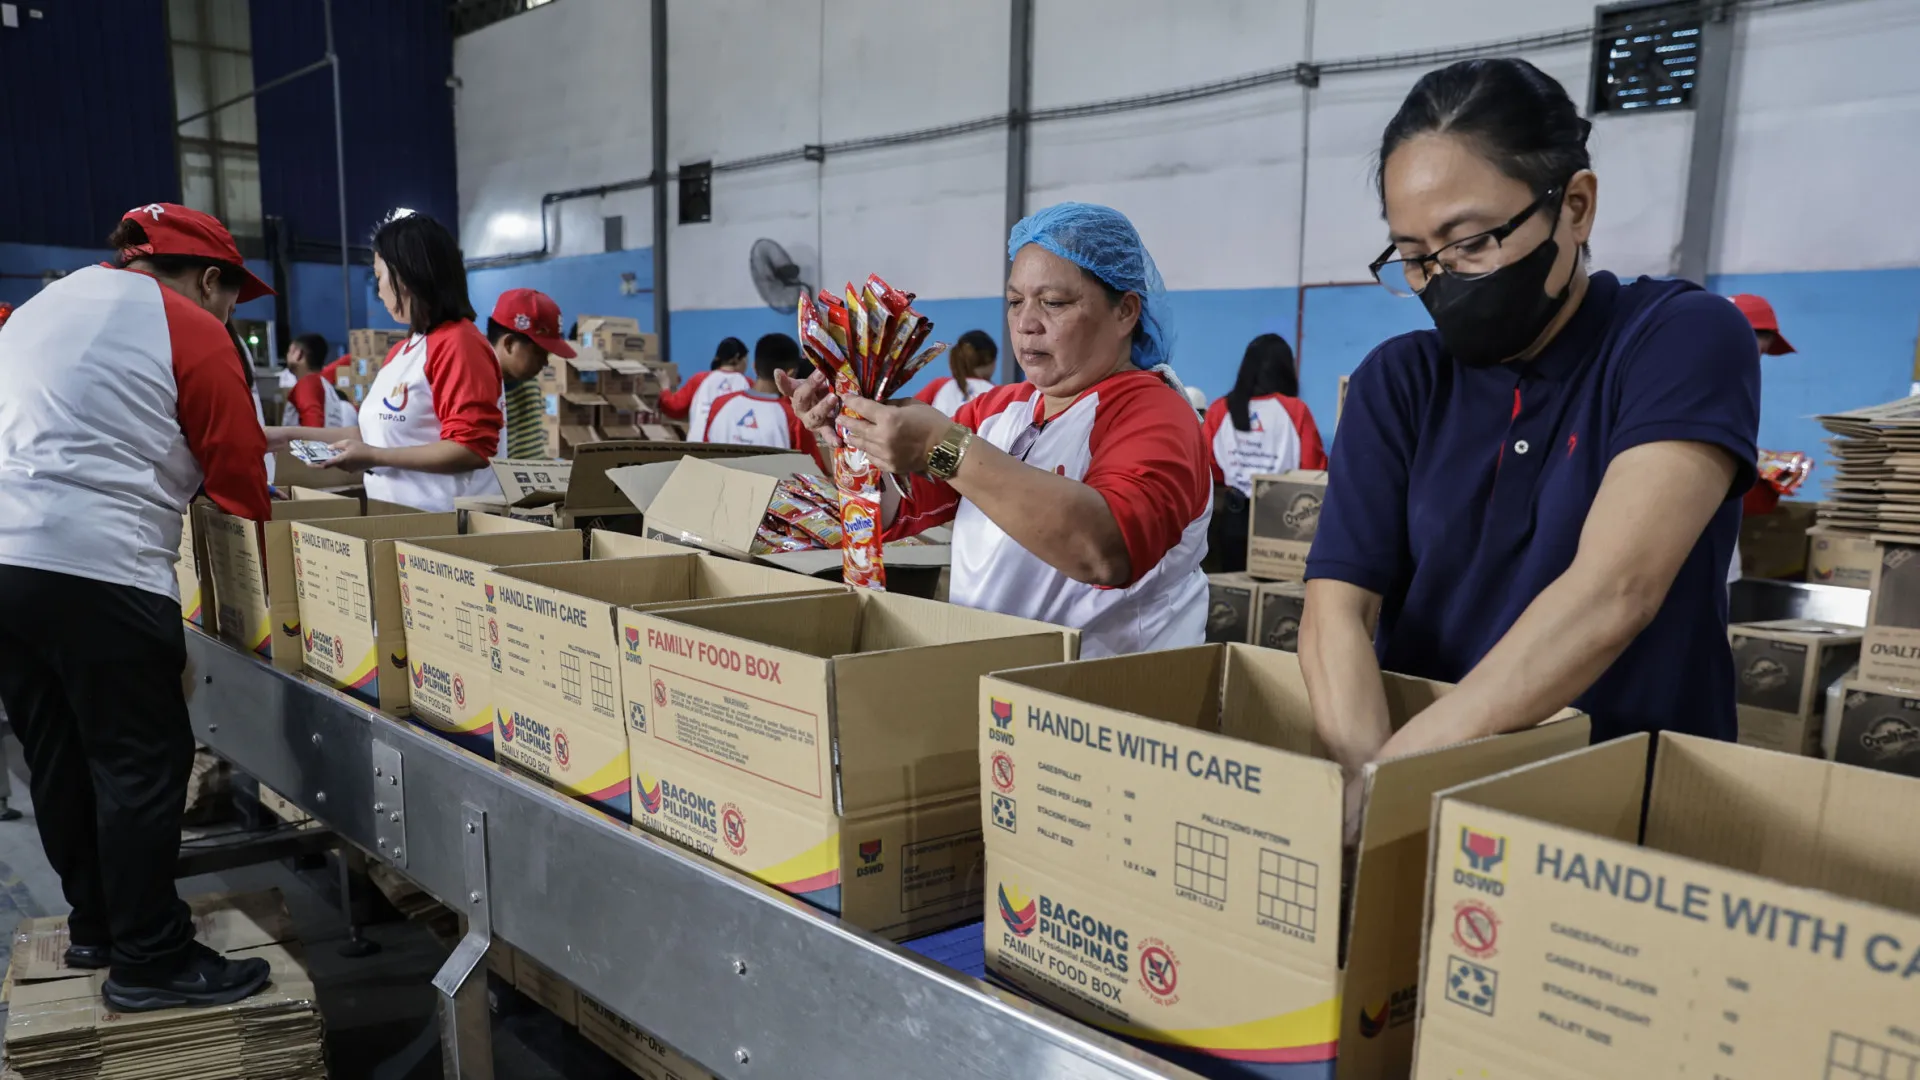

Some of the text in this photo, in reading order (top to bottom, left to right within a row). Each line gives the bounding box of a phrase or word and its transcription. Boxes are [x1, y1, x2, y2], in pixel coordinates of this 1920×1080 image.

[302, 532, 351, 557] HANDLE WITH CARE
[408, 554, 476, 587] HANDLE WITH CARE
[498, 585, 533, 611] HANDLE
[533, 597, 558, 620] WITH
[559, 604, 587, 629] CARE
[423, 662, 450, 685] BAGONG
[647, 628, 782, 684] FAMILY FOOD BOX
[424, 674, 452, 697] PILIPINAS
[514, 711, 551, 741] BAGONG
[515, 727, 552, 755] PILIPINAS
[989, 728, 1015, 746] DSWD
[501, 741, 520, 760] FAMILY
[520, 751, 537, 769] FOOD
[537, 761, 551, 777] BOX
[1028, 705, 1262, 794] HANDLE WITH CARE
[1037, 761, 1083, 783] CASES/PALLET
[661, 779, 717, 818] BAGONG
[663, 798, 718, 834] PILIPINAS
[641, 812, 715, 858] FAMILY FOOD BOX
[856, 863, 884, 878] DSWD
[1453, 867, 1505, 897] DSWD
[1536, 843, 1711, 922] HANDLE
[1721, 891, 1848, 961] WITH
[1039, 894, 1130, 953] BAGONG
[1039, 916, 1130, 974] PILIPINAS
[1039, 935, 1130, 986] Presidential Action Center
[1003, 932, 1046, 966] FAMILY
[1048, 955, 1088, 986] FOOD
[1091, 976, 1123, 1004] BOX
